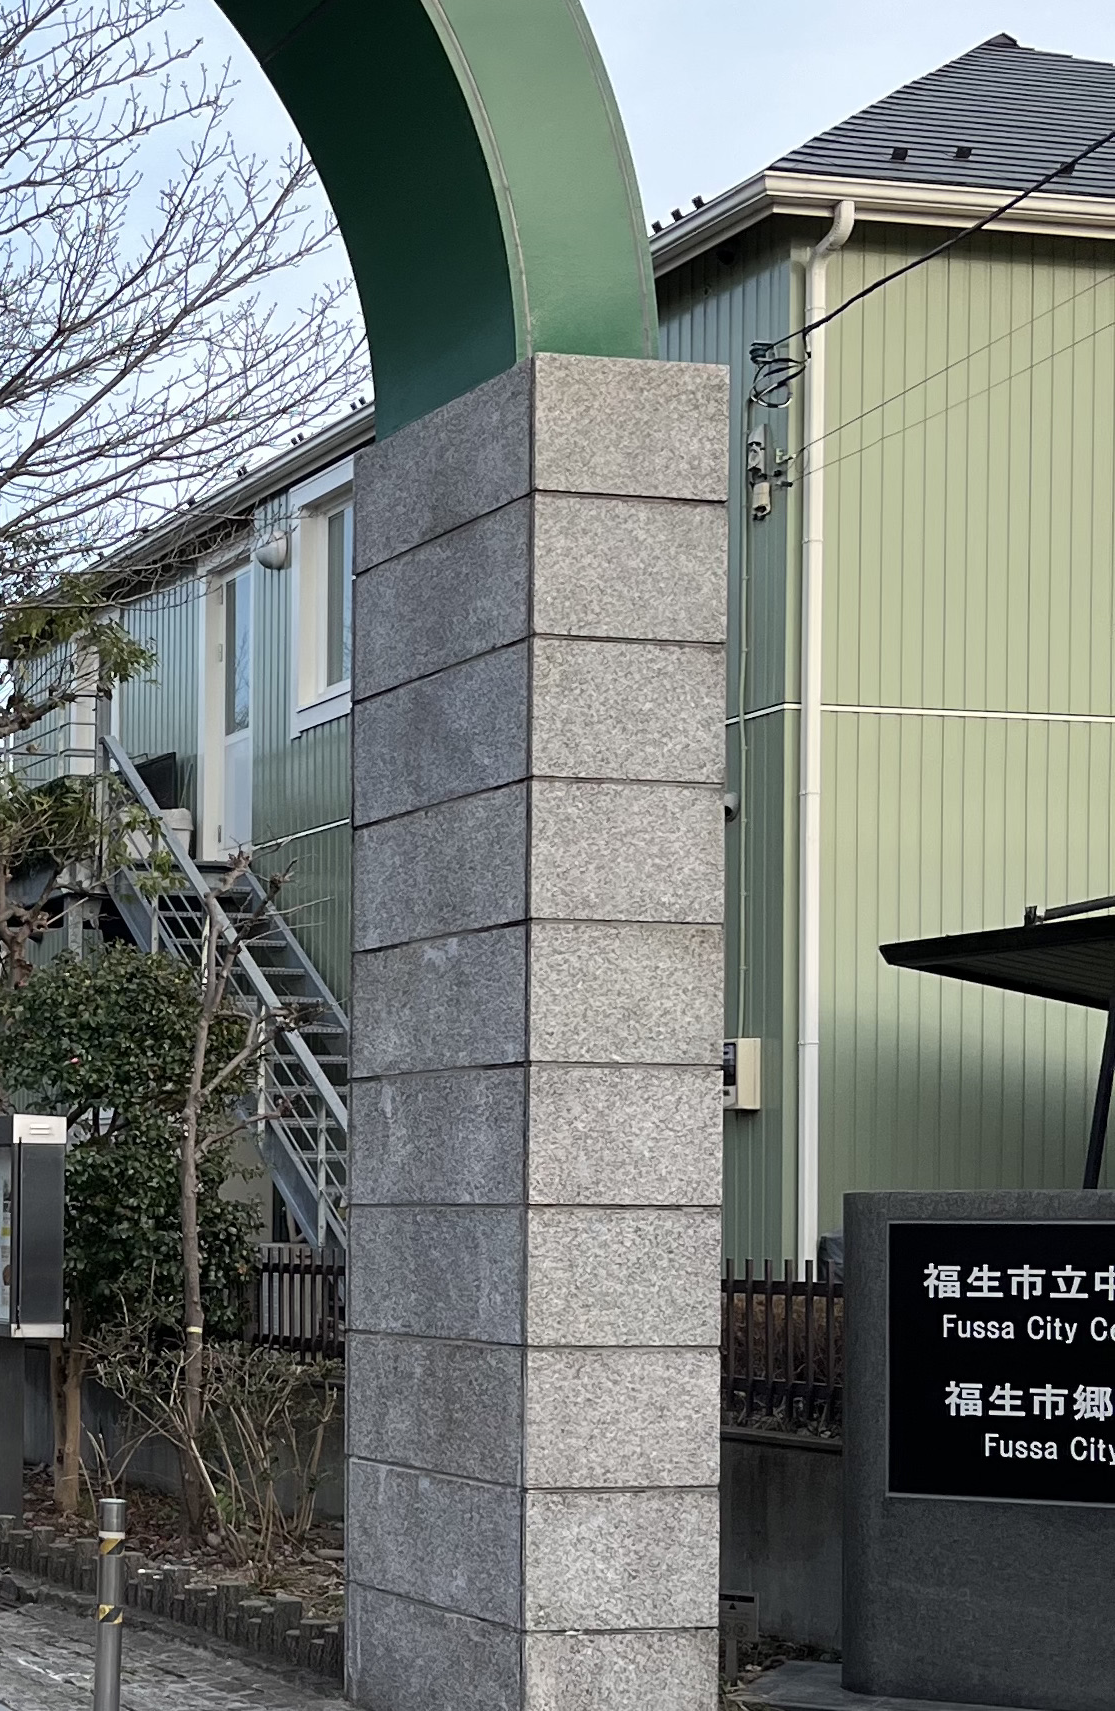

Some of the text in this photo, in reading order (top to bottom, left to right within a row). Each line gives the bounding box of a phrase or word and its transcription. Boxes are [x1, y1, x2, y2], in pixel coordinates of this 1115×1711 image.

[942, 1314, 1015, 1340] Fussa
[1027, 1316, 1078, 1344] City
[945, 1381, 1114, 1421] 福生市郷
[985, 1433, 1058, 1460] Fussa
